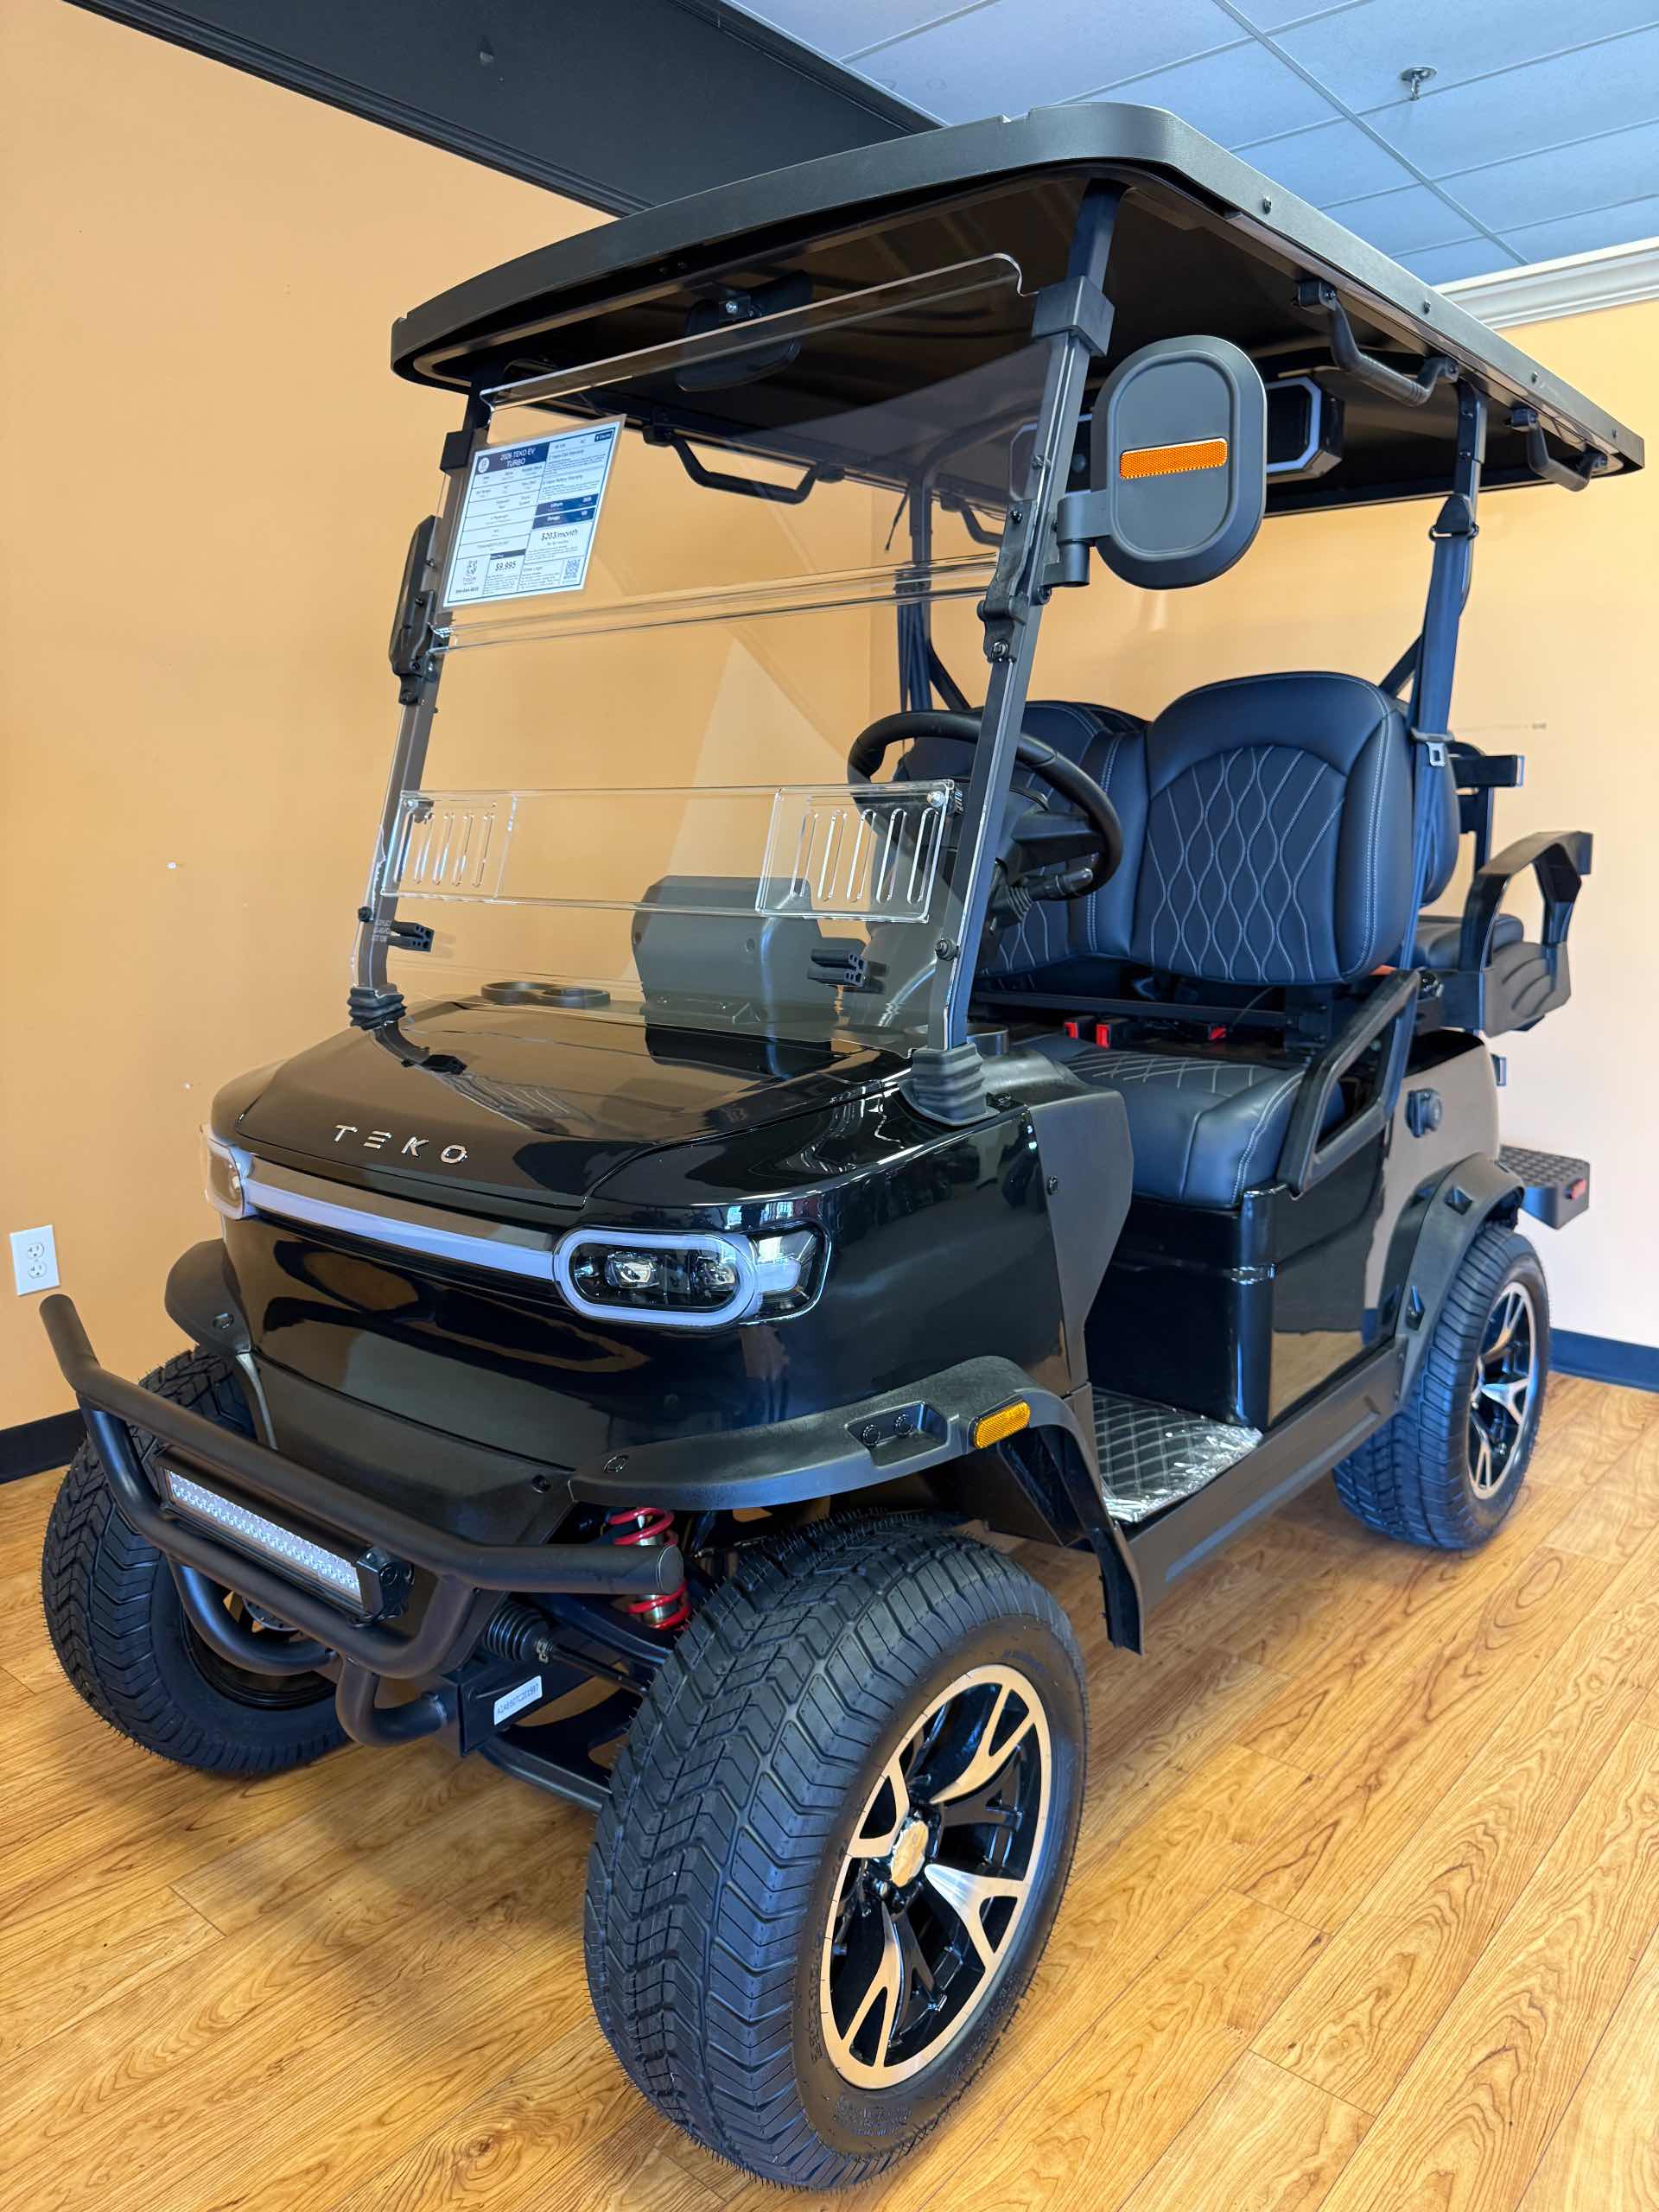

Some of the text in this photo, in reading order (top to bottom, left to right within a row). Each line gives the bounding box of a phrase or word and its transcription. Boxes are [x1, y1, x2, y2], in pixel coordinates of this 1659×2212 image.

[500, 452, 512, 461] 2026
[513, 448, 527, 458] TEKO
[506, 457, 526, 467] TURBO
[541, 528, 579, 542] $203/month
[334, 1124, 467, 1164] TEKO
